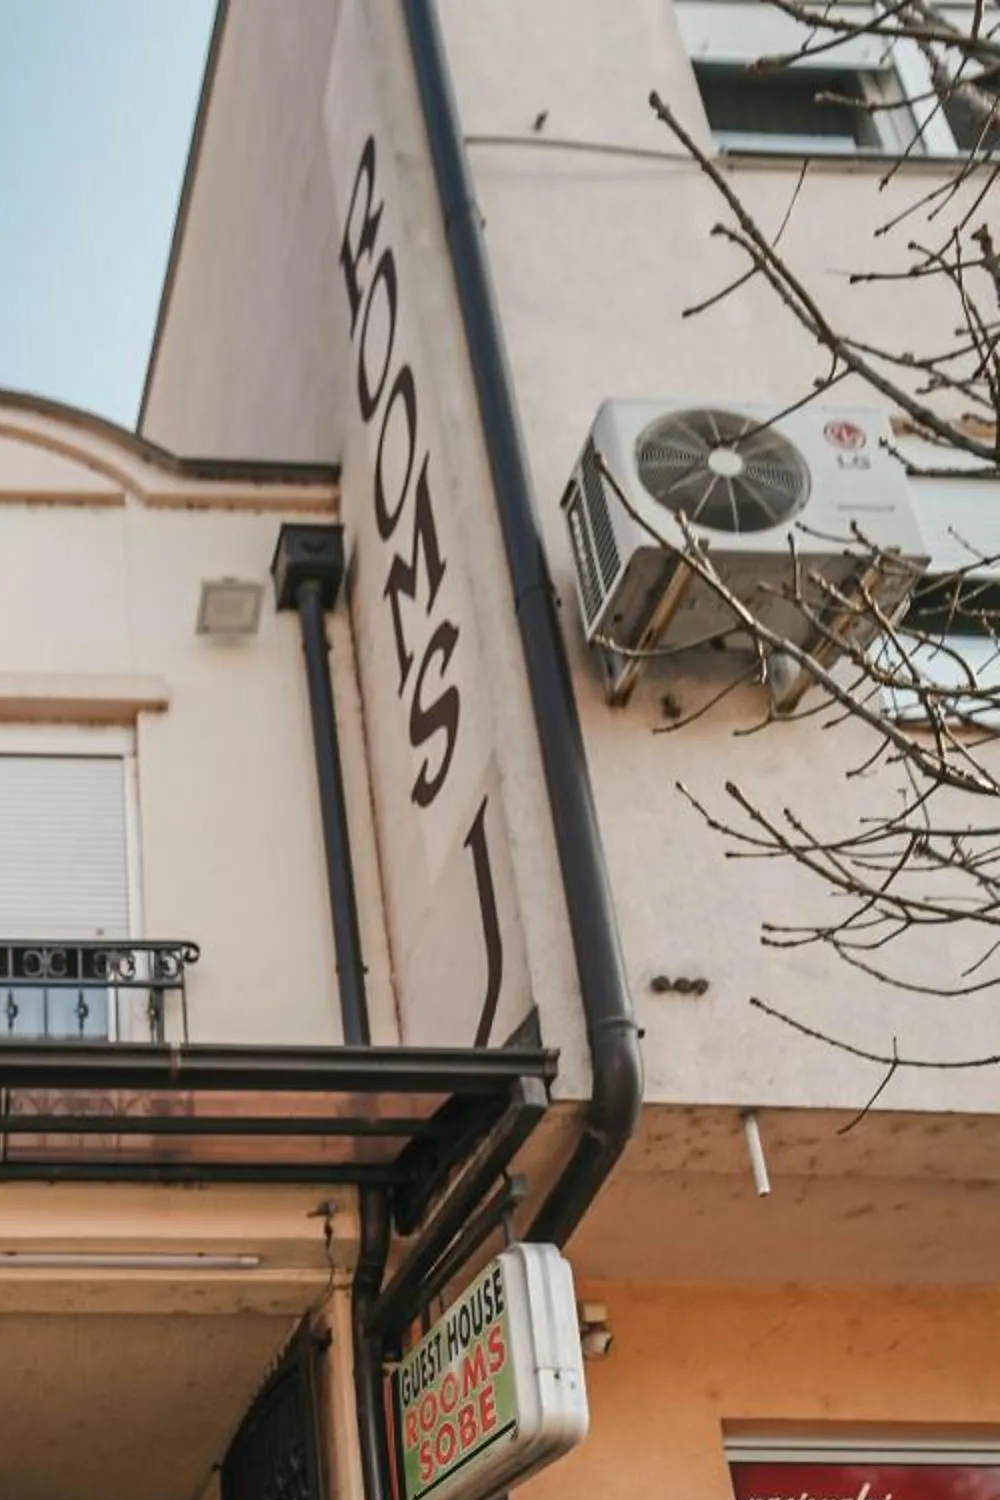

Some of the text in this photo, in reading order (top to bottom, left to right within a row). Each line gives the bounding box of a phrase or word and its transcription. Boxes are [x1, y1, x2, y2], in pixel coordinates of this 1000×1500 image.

[338, 134, 463, 808] ROOMS
[401, 1268, 504, 1408] GUEST HOUSE
[405, 1325, 506, 1448] ROOMS
[418, 1385, 497, 1483] SOBE
